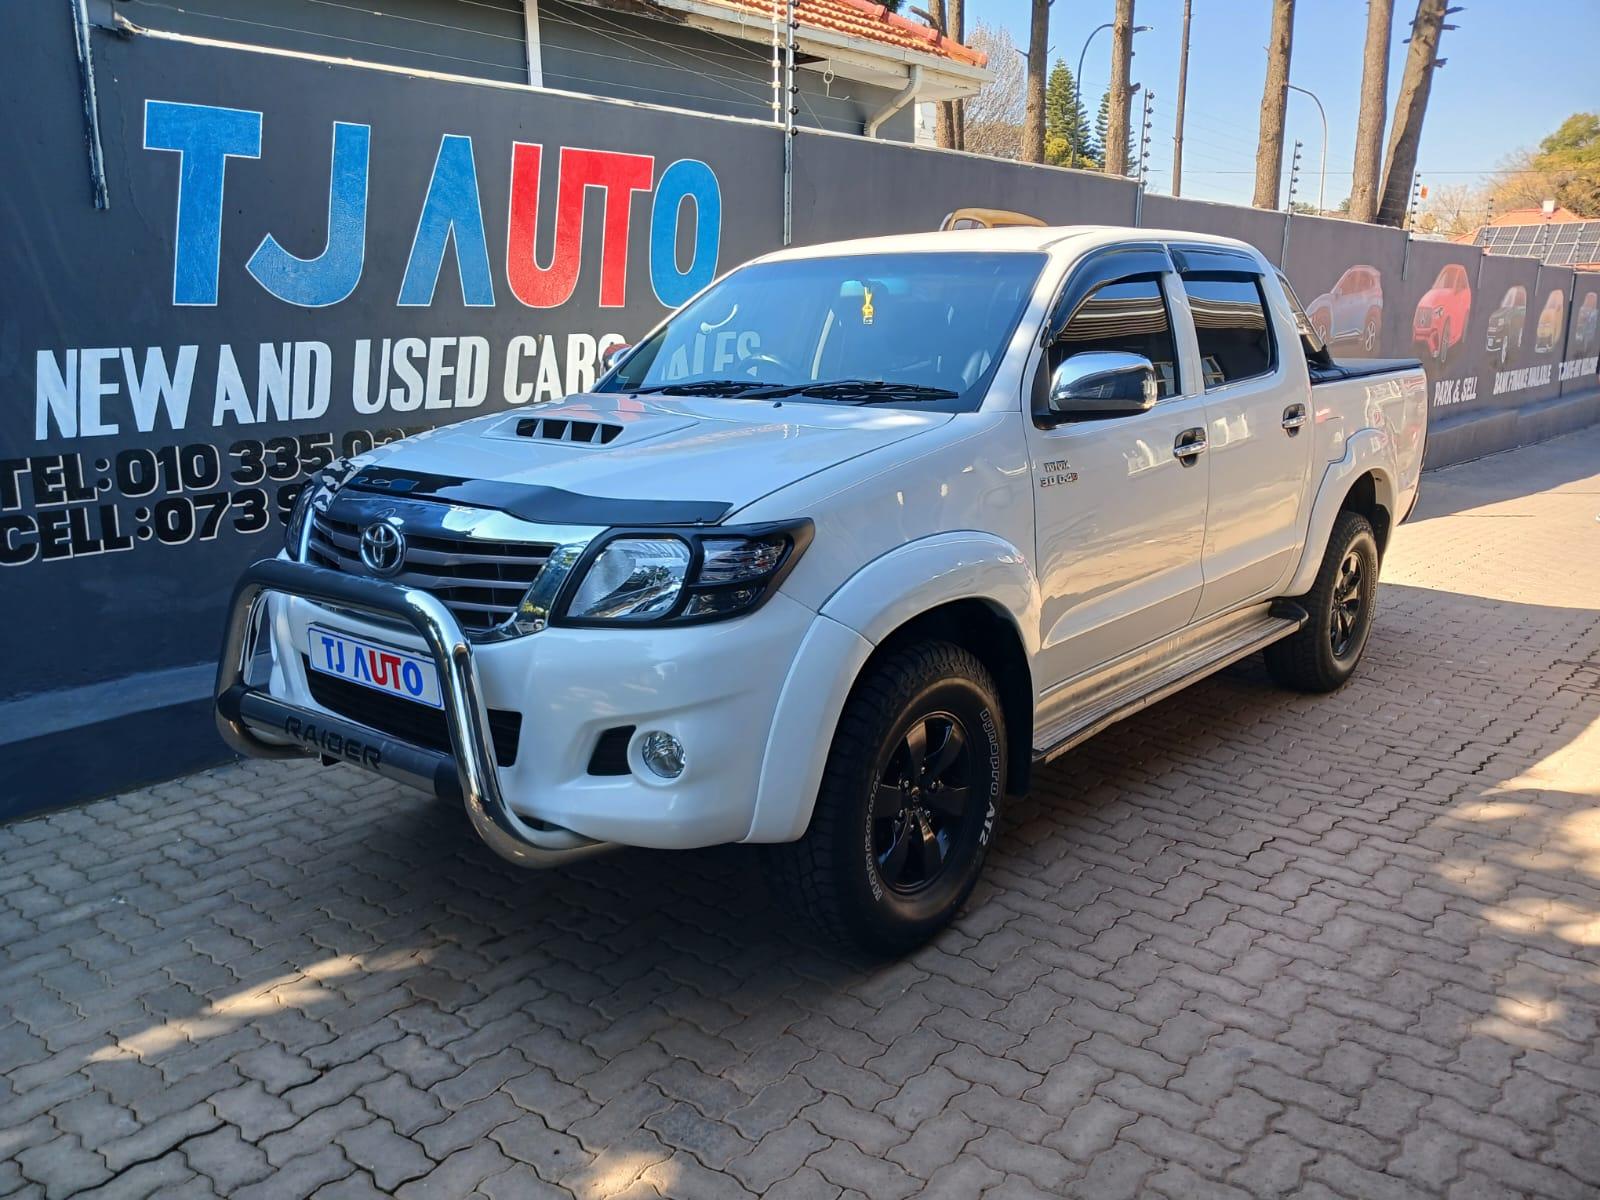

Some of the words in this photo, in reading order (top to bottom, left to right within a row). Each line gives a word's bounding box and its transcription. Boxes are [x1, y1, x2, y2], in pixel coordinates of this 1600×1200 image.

[143, 99, 371, 308] TJ
[396, 134, 722, 309] AUTO
[35, 344, 199, 441] NEW
[212, 341, 333, 427] AND
[353, 335, 490, 415] USED
[1433, 380, 1452, 407] PARK
[1453, 380, 1460, 403] &
[1461, 376, 1478, 401] SELL
[229, 433, 335, 486] 335
[321, 636, 345, 674] TJ
[353, 646, 423, 696] AUTO
[284, 715, 383, 770] RAIDER
[979, 801, 996, 846] AT2
